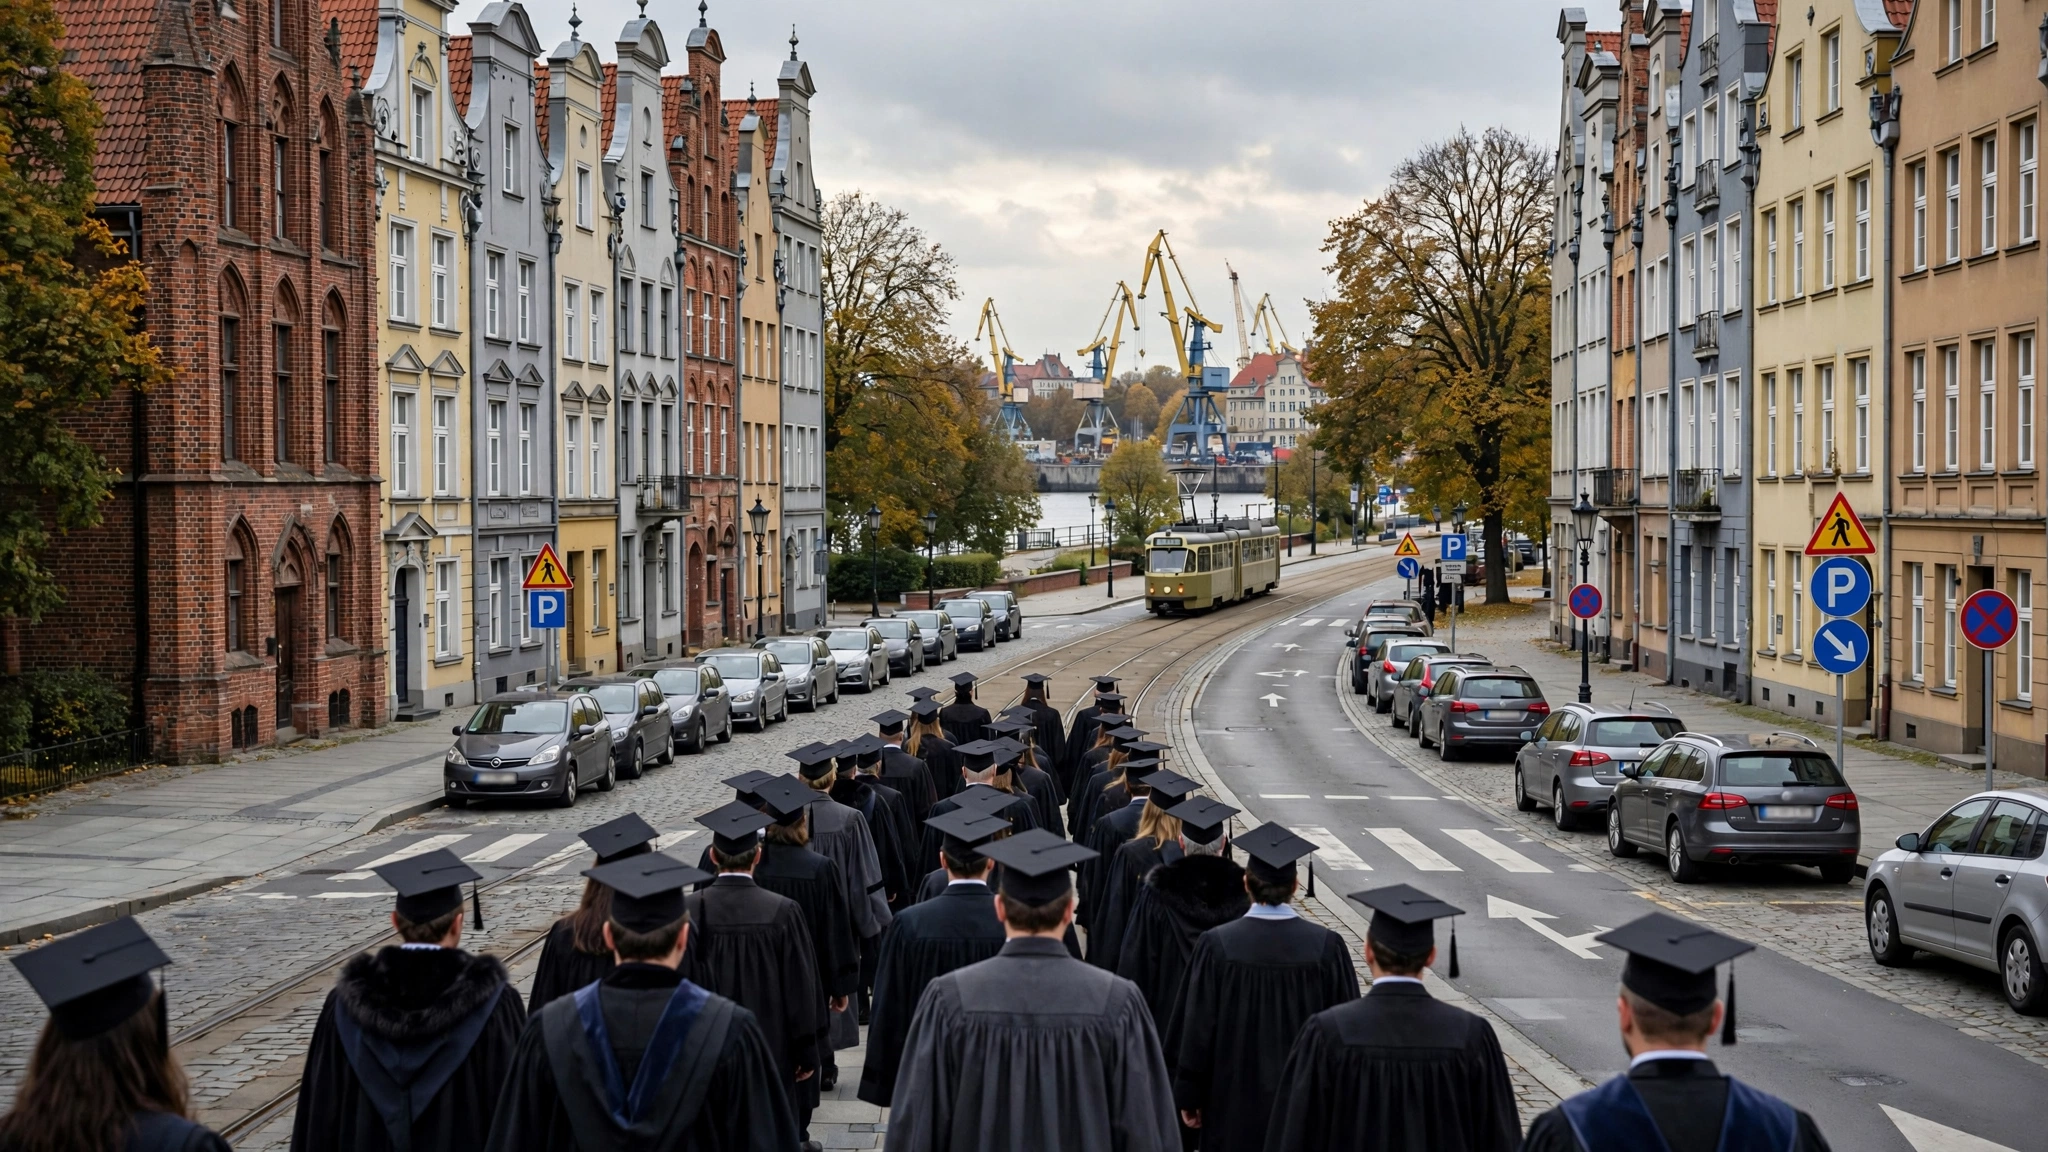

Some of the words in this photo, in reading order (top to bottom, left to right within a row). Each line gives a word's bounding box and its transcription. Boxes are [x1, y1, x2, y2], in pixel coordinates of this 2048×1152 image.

[1447, 537, 1461, 558] P
[1827, 567, 1856, 608] P
[538, 595, 558, 624] P
